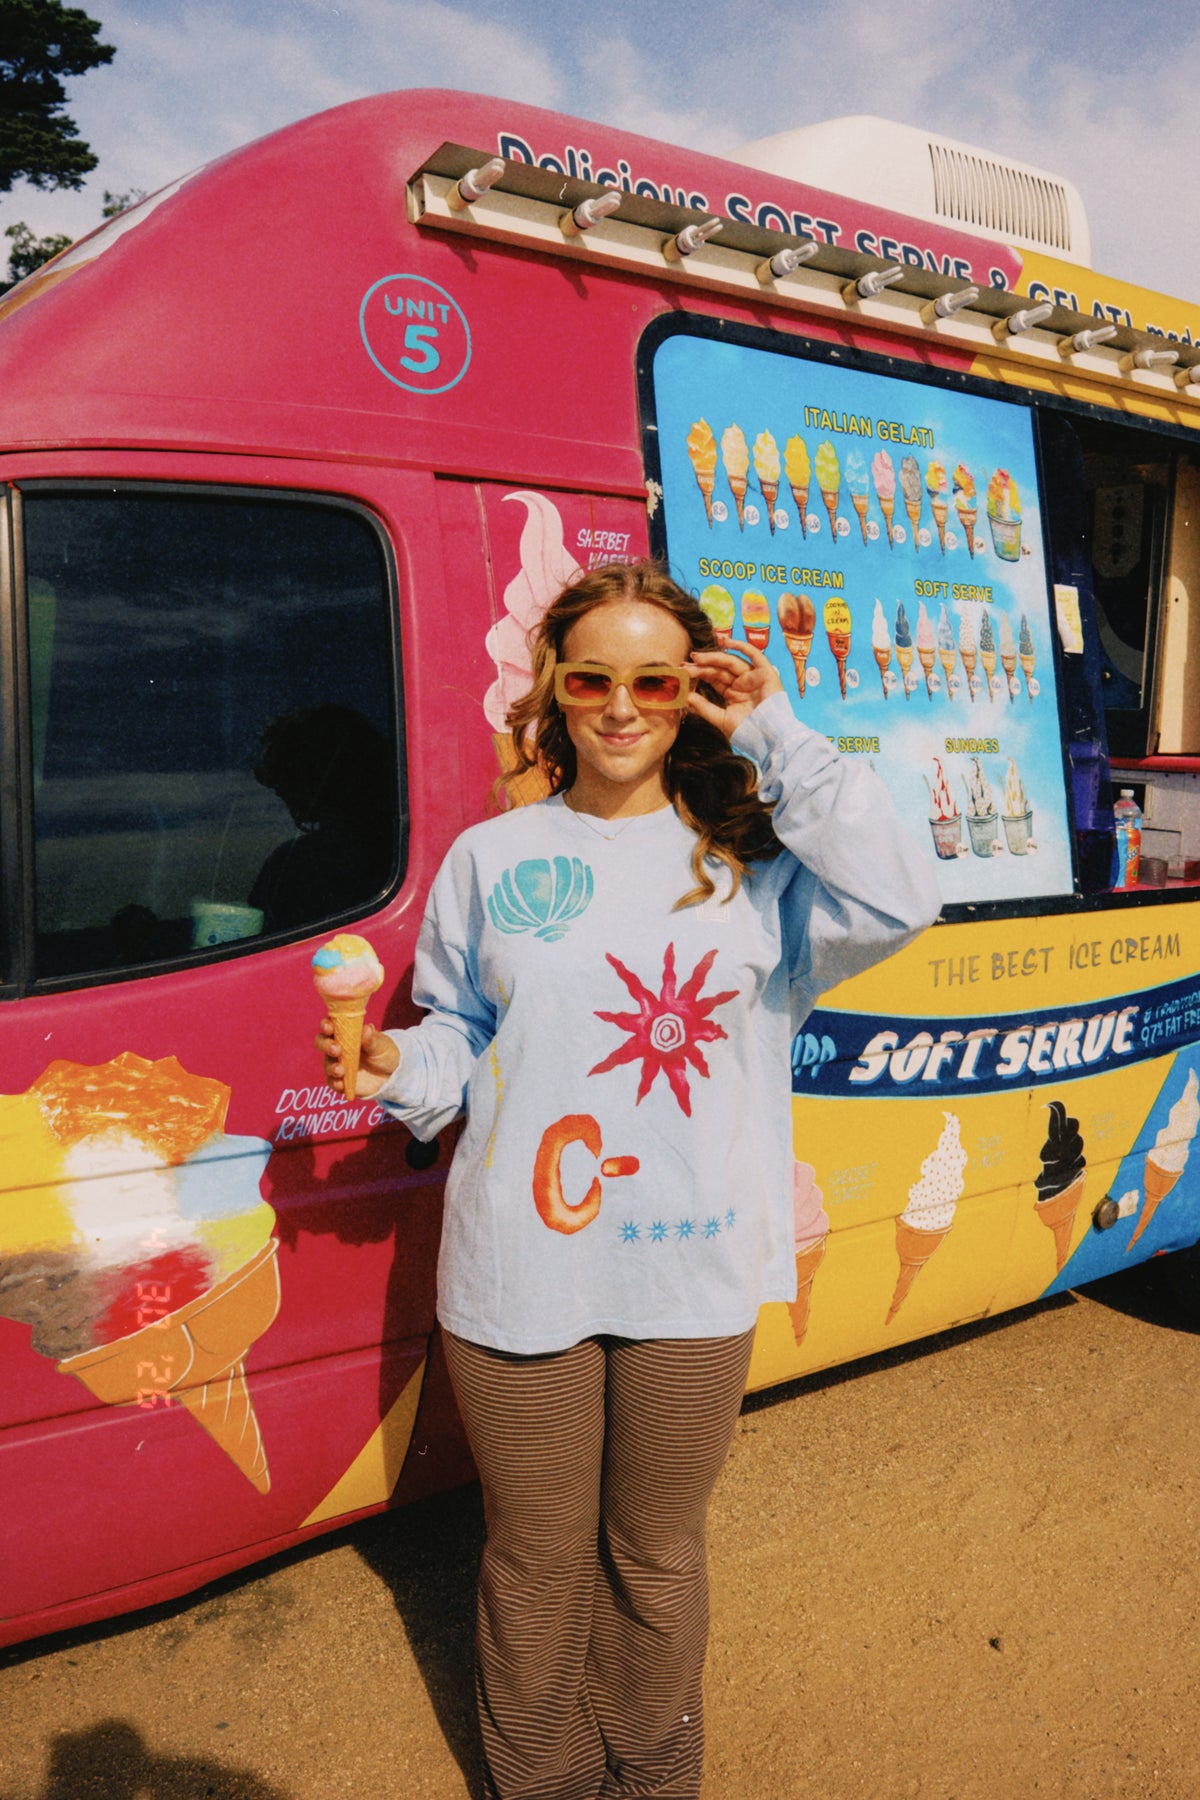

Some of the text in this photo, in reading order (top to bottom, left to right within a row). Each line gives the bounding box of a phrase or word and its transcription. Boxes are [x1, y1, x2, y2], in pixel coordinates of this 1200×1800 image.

[384, 293, 450, 324] UNIT
[400, 324, 440, 373] 5
[804, 405, 934, 449] ITALIAN GELATI
[576, 528, 631, 551] SHERBET
[699, 557, 844, 590] SCOOP ICE CREAM
[914, 579, 993, 603] SOFT SERVE
[837, 736, 880, 753] SERVE
[945, 738, 999, 753] SUNDAES
[928, 933, 1181, 988] THE BEST ICE CREAM
[1165, 1015, 1183, 1037] FAT
[848, 1030, 1000, 1085] SOFT
[996, 1006, 1139, 1078] SERVE
[275, 1106, 367, 1141] RAINBOW
